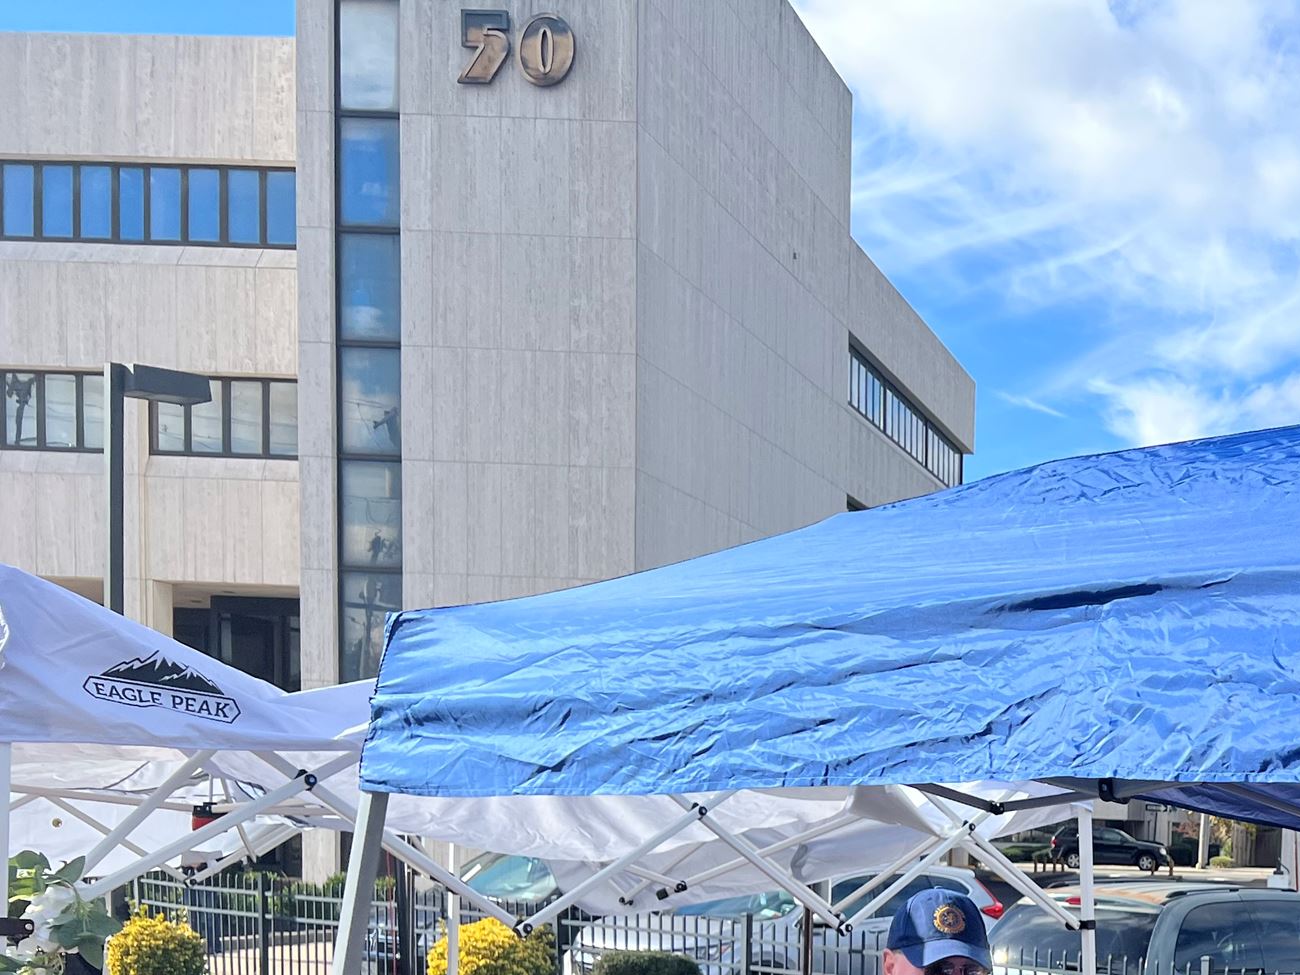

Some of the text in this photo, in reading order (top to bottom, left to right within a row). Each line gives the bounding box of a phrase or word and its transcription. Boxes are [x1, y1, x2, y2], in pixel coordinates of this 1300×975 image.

[457, 9, 576, 88] 50
[93, 681, 230, 718] EAGLE PEAK
